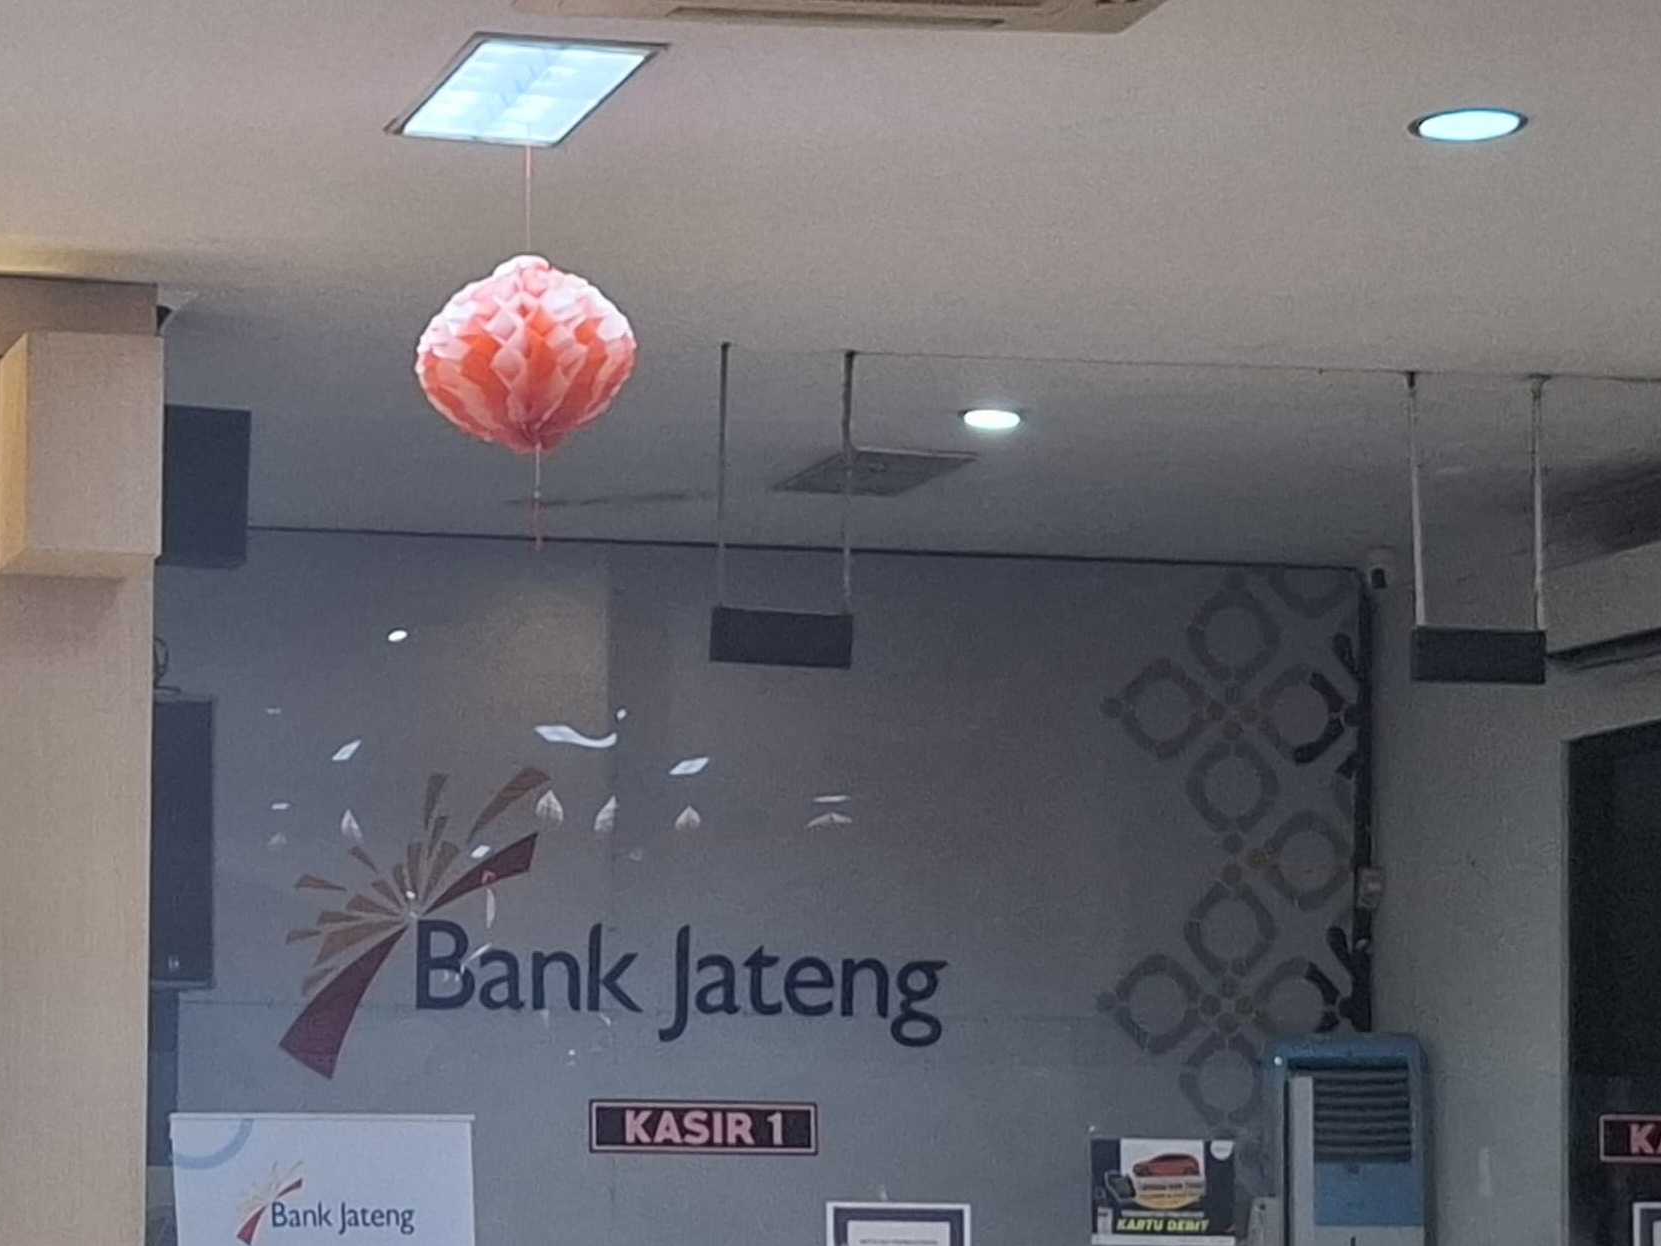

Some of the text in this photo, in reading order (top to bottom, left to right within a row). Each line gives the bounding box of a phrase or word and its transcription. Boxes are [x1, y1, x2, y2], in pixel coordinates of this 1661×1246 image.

[413, 919, 949, 1048] Bank Jateng
[623, 1110, 785, 1147] KASIR 1
[271, 1200, 416, 1235] Bank Jateng
[1116, 1218, 1210, 1232] KARTU DEBIT
